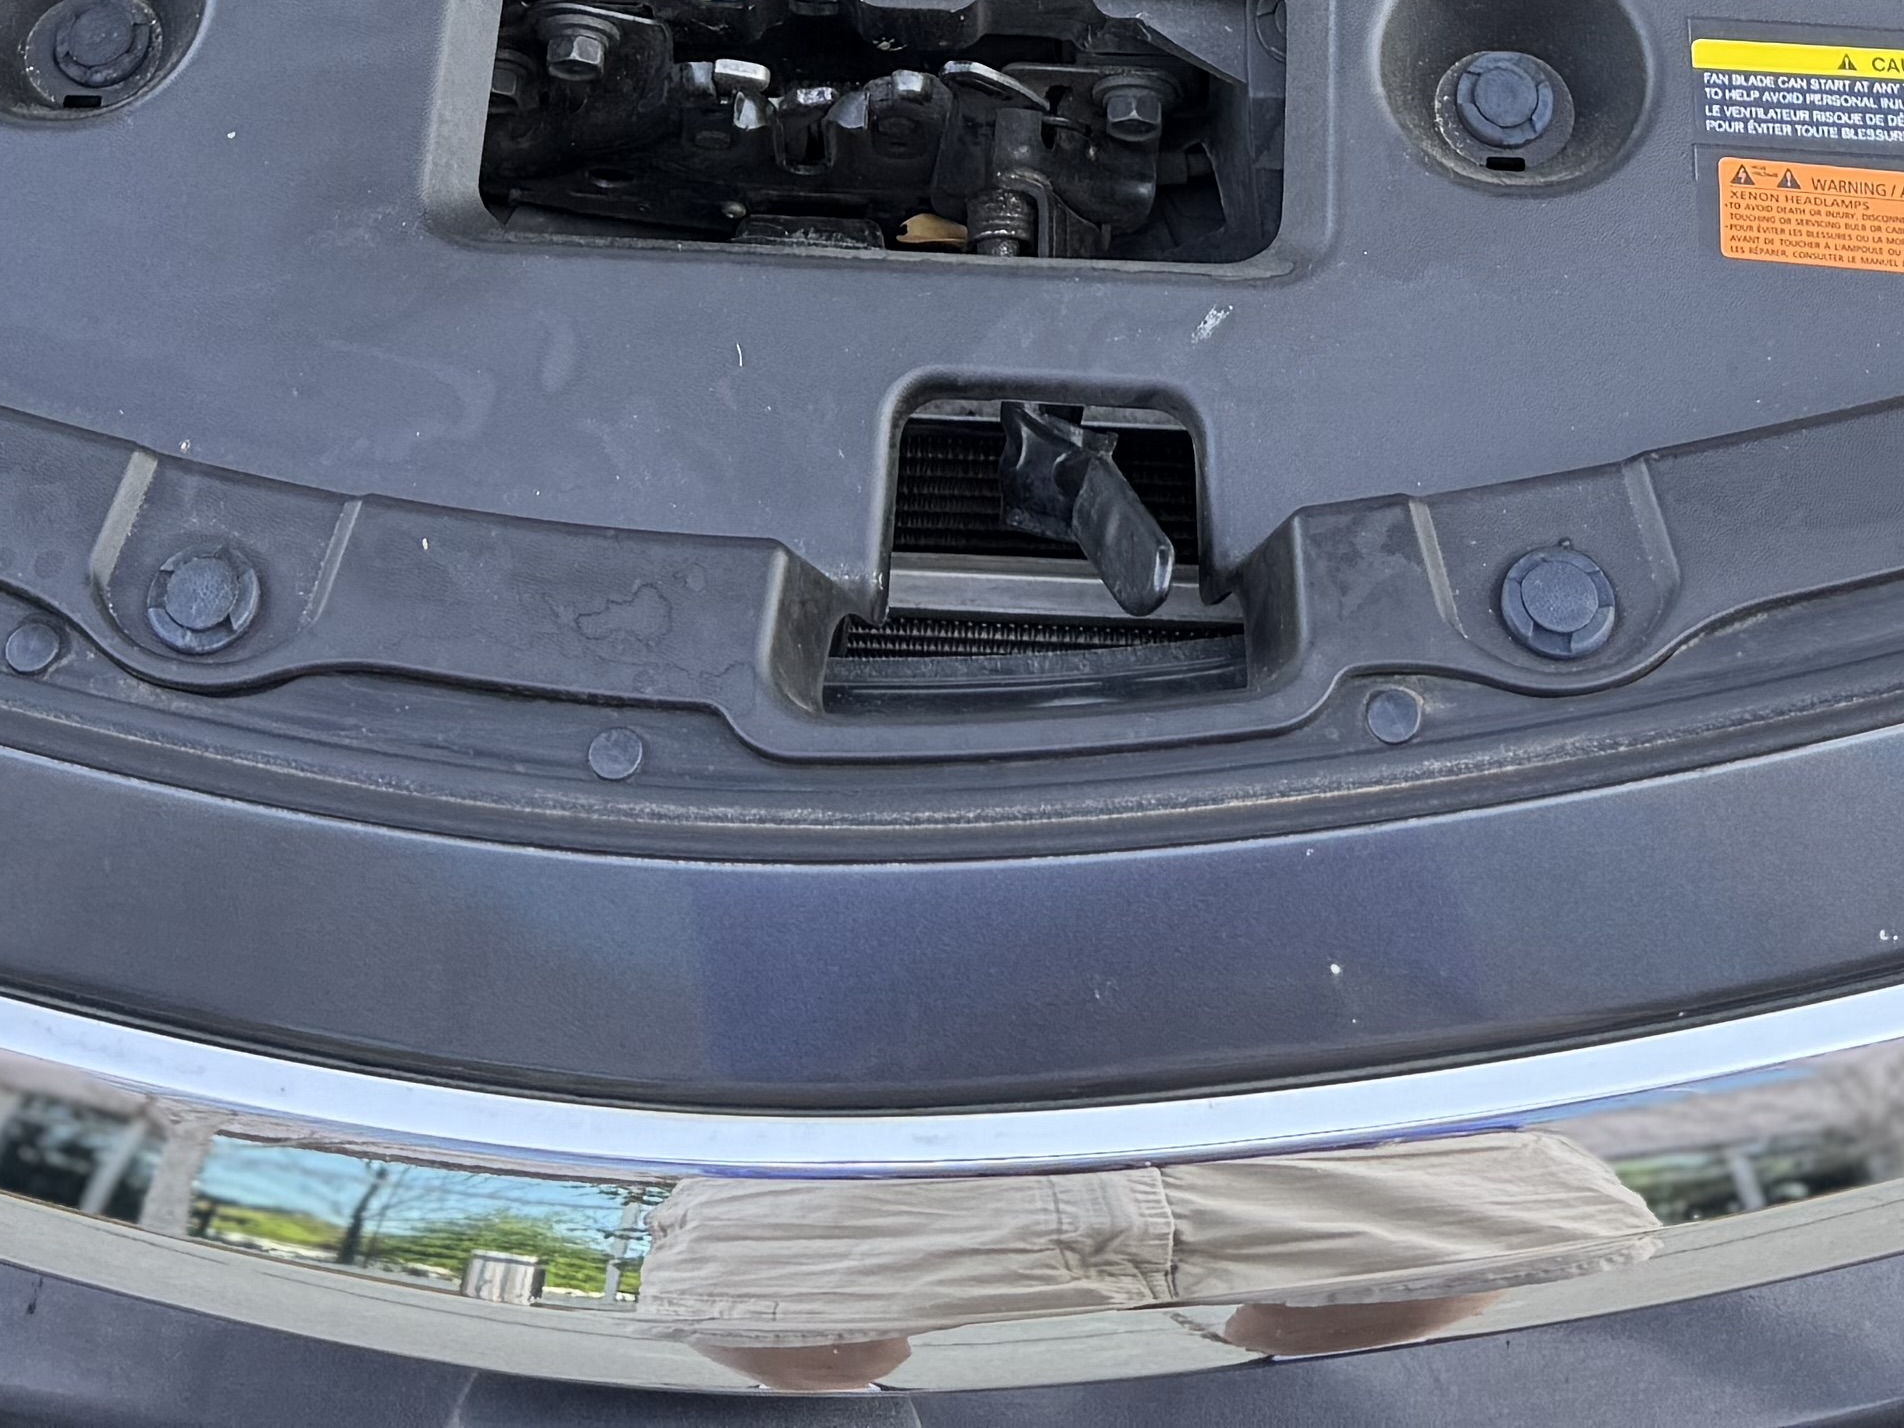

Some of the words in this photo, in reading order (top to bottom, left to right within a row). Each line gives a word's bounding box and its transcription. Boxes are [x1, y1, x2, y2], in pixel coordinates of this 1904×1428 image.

[1703, 73, 1728, 85] FAN
[1731, 74, 1775, 88] BLADE
[1777, 76, 1807, 89] CAN
[1810, 78, 1851, 91] START
[1854, 81, 1869, 92] AT
[1873, 82, 1900, 94] ANY
[1704, 88, 1722, 99] TO
[1725, 90, 1759, 101] HELP
[1762, 92, 1803, 104] AVOID
[1806, 94, 1878, 108] PERSONAL
[1705, 105, 1720, 116] LE
[1723, 106, 1809, 121] VENTILATEUR
[1812, 111, 1863, 125] RISQUE
[1865, 114, 1884, 126] DE
[1705, 121, 1744, 133] POUR
[1794, 126, 1838, 138] TOUTE
[1811, 177, 1886, 196] WARNING
[1890, 184, 1896, 197] /
[1730, 191, 1779, 203] XENON
[1785, 195, 1869, 209] HEADLAMPS
